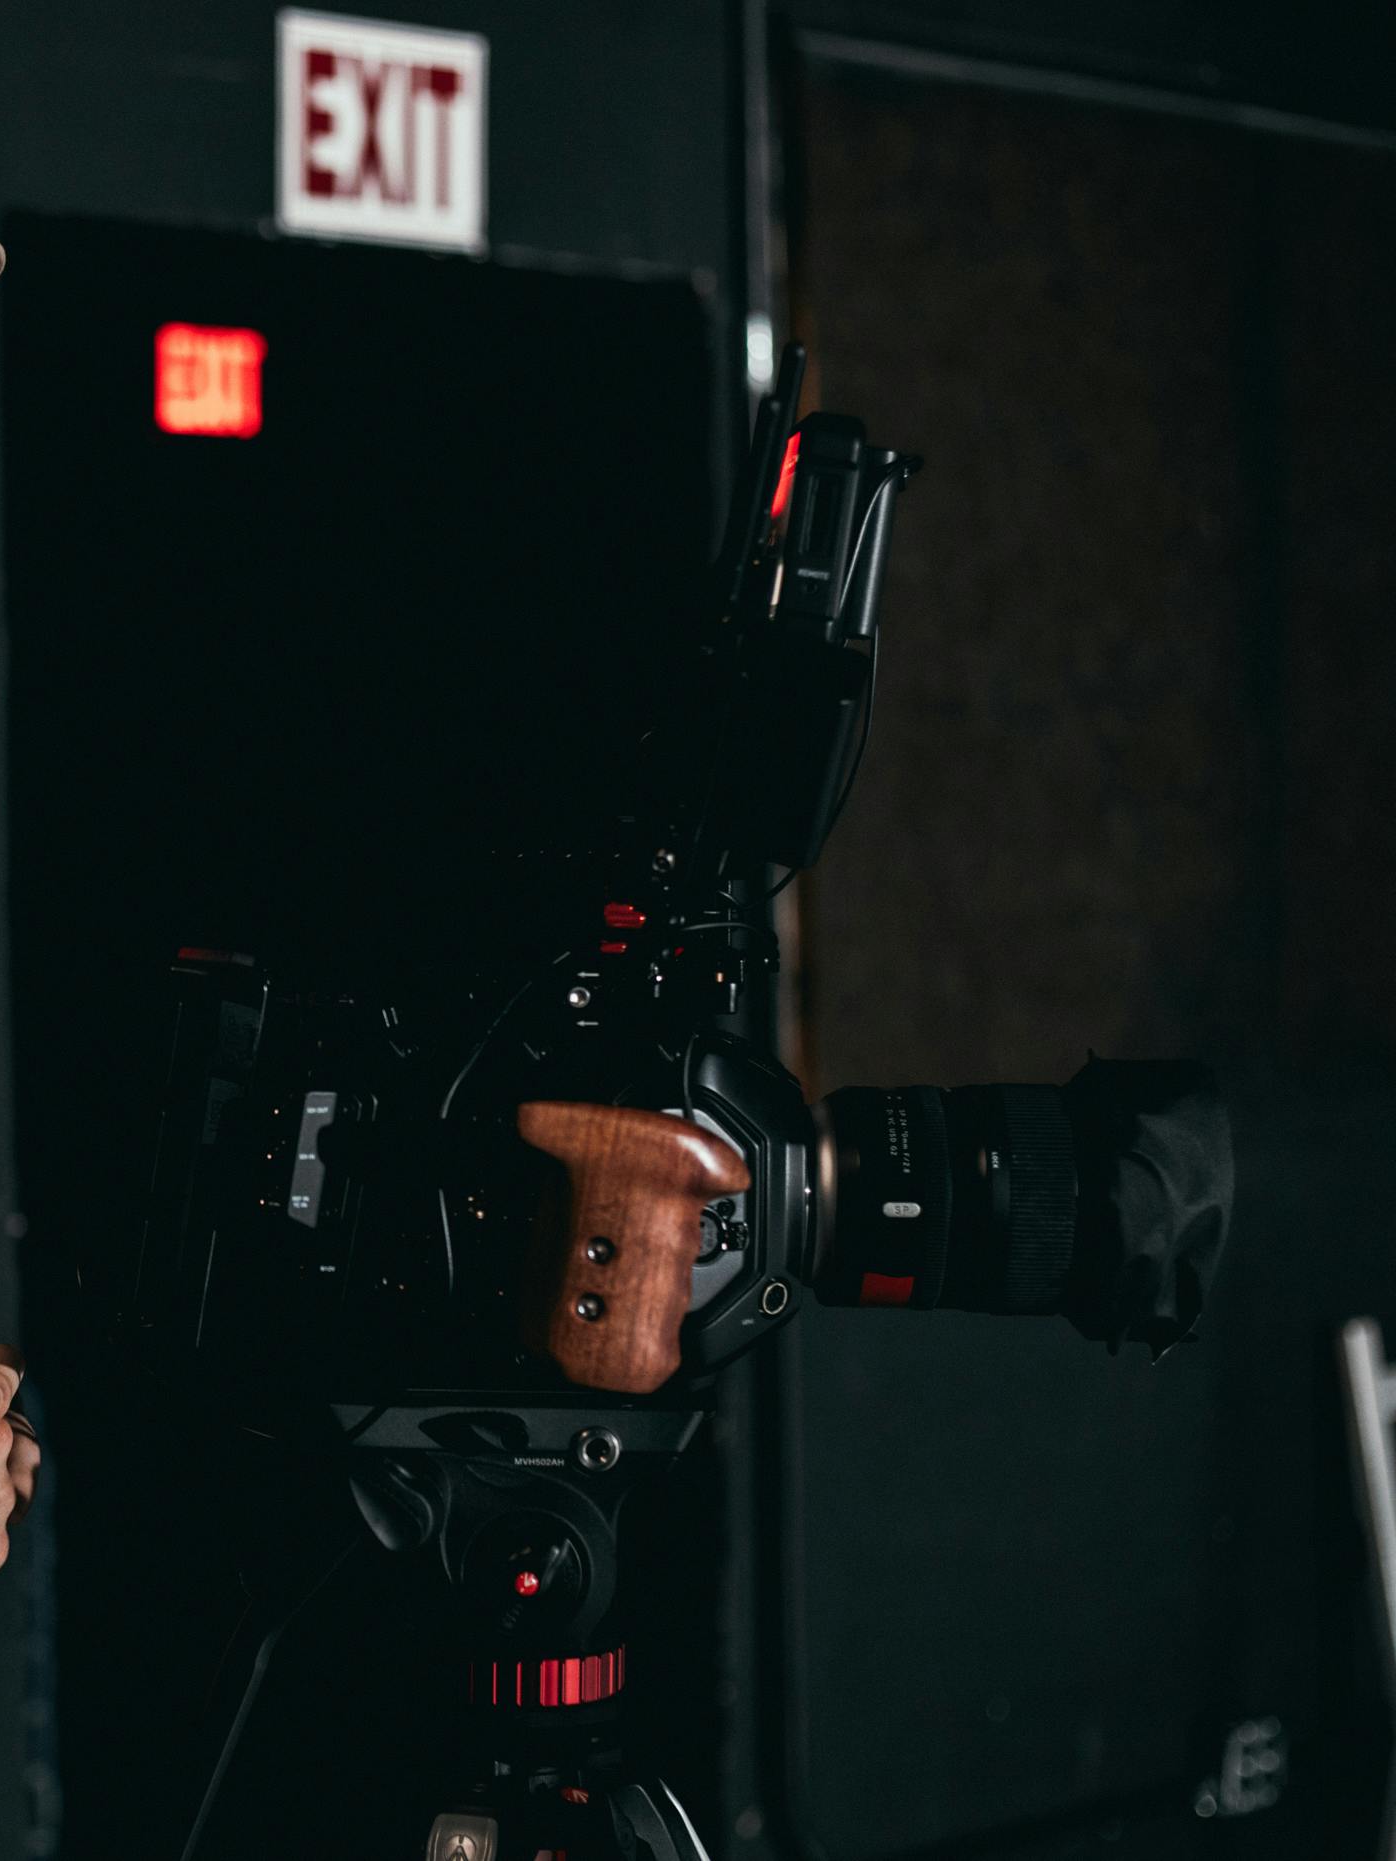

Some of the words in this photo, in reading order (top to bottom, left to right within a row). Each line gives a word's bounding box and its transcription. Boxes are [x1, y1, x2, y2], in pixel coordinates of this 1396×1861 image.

[301, 48, 462, 209] EXIT
[991, 1151, 1000, 1169] LOCK
[894, 1205, 909, 1215] SP
[514, 1458, 565, 1466] MVH502AH
